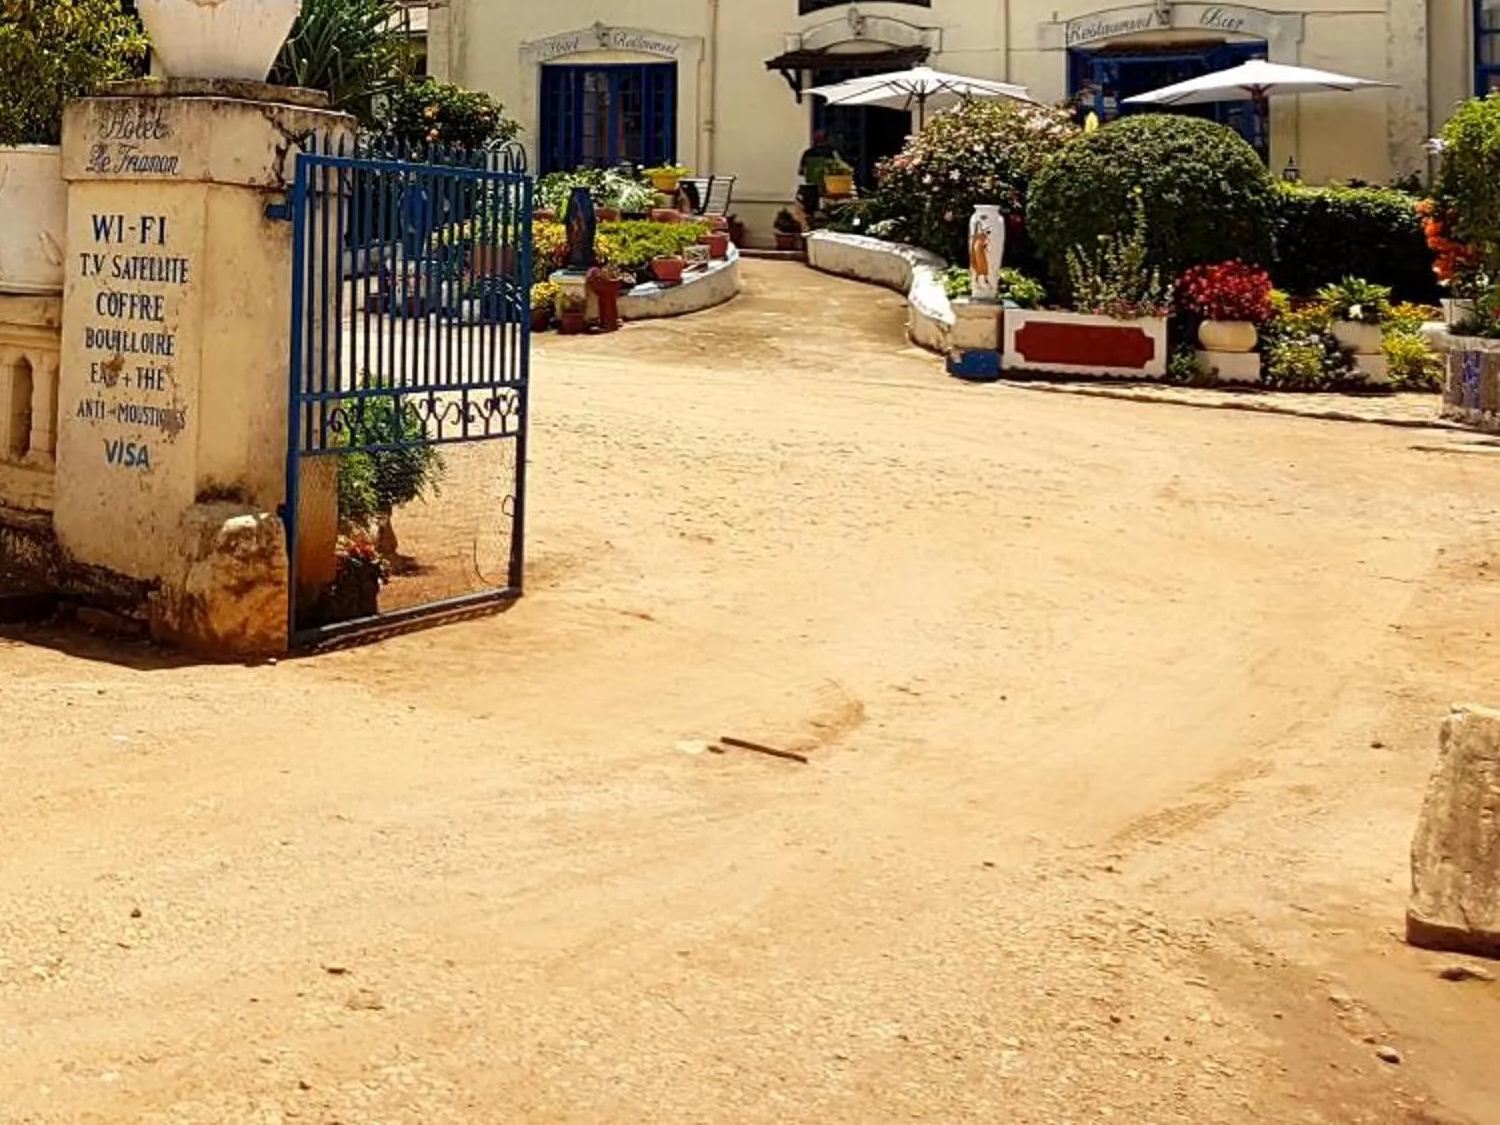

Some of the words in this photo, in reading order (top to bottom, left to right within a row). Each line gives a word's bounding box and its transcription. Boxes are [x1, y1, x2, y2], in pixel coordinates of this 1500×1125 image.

[1199, 7, 1244, 30] Bar
[92, 214, 167, 246] WI-FI
[111, 255, 189, 284] SATELLITE
[96, 292, 164, 322] COFFRE
[85, 327, 175, 356] BOUILLOIRE
[104, 438, 150, 468] VISA
